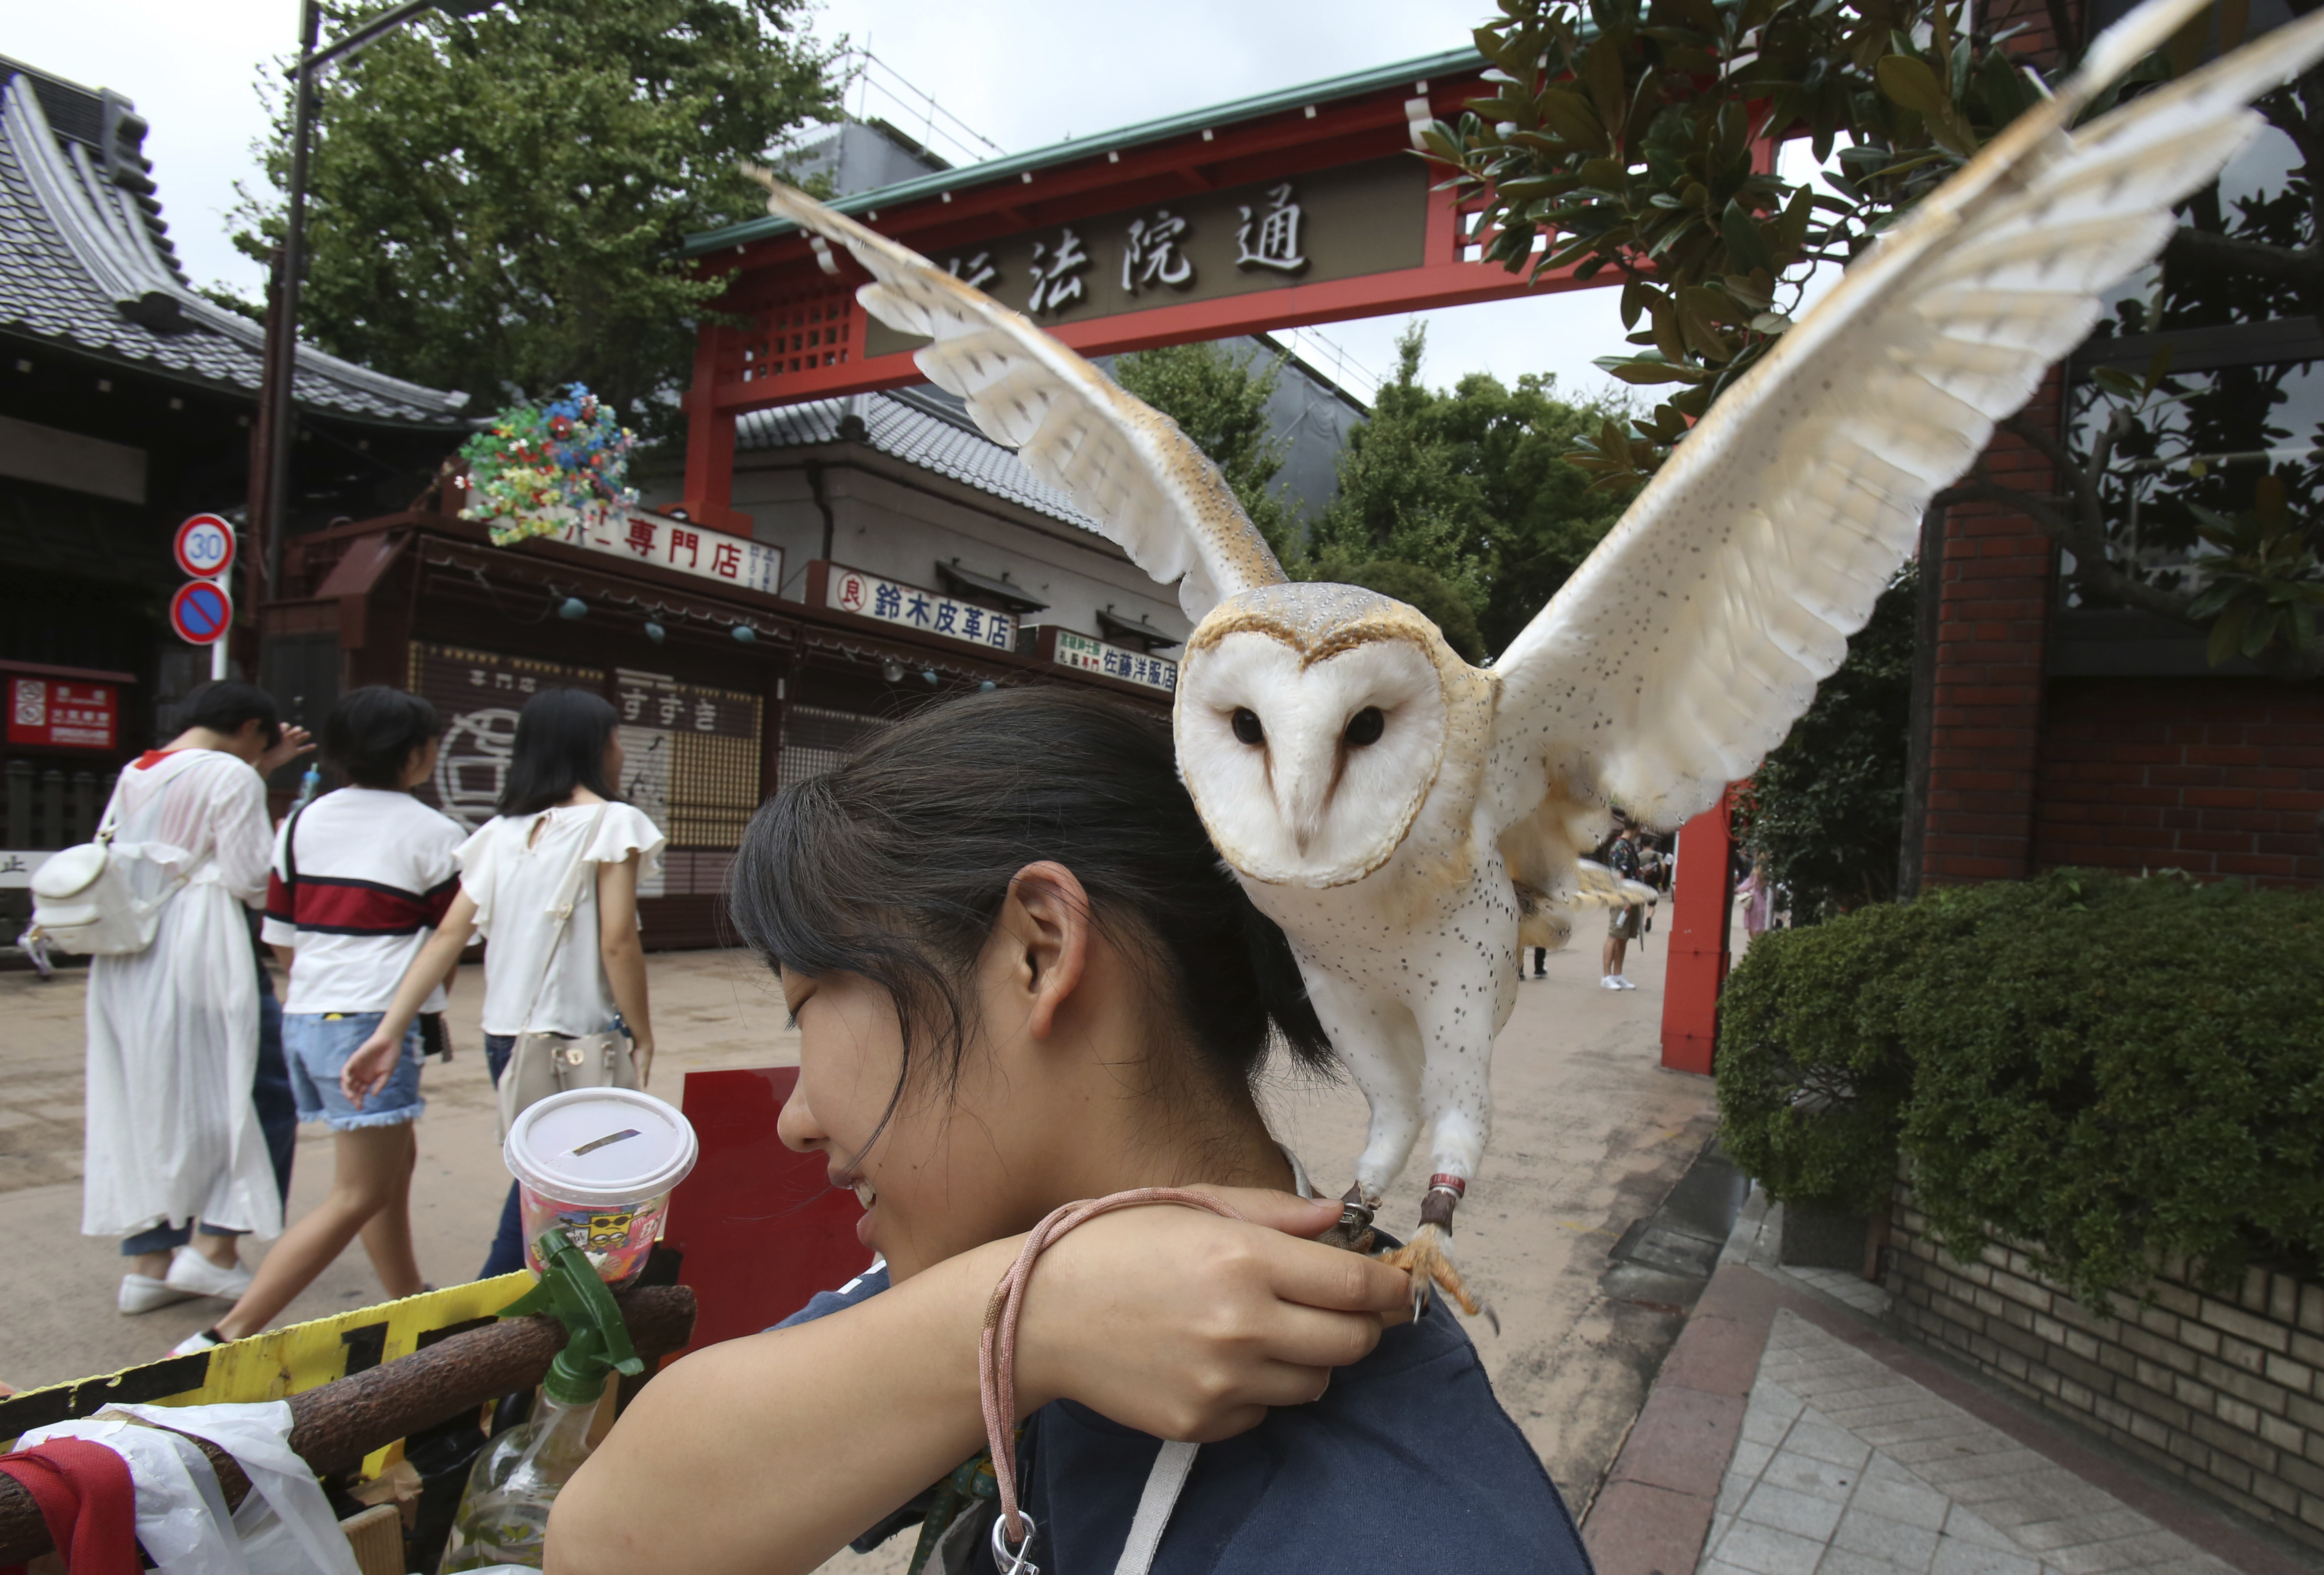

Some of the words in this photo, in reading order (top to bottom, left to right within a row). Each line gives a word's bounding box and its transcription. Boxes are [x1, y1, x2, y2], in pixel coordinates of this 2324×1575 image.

[190, 533, 222, 559] 30
[844, 578, 860, 606] 良
[874, 583, 1009, 649] 鈴木皮革店
[1104, 649, 1176, 689] 佐藤洋服店
[619, 687, 716, 731] すずき
